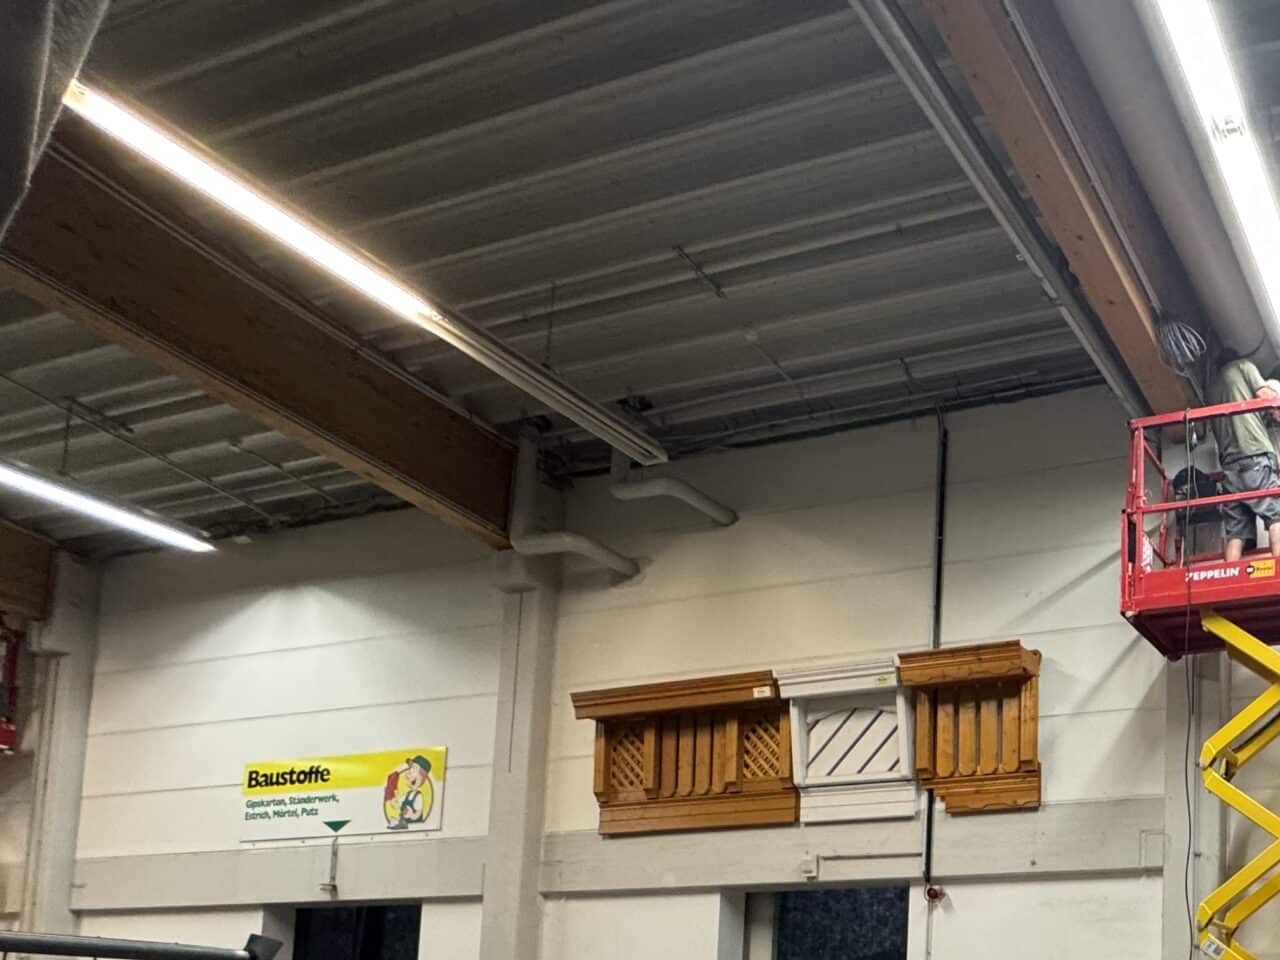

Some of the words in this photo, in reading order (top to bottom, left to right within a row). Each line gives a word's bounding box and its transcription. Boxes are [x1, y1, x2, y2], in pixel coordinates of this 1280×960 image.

[1185, 567, 1240, 582] ZEPPELIN
[247, 764, 331, 789] Baustoffe
[301, 806, 319, 817] Putz
